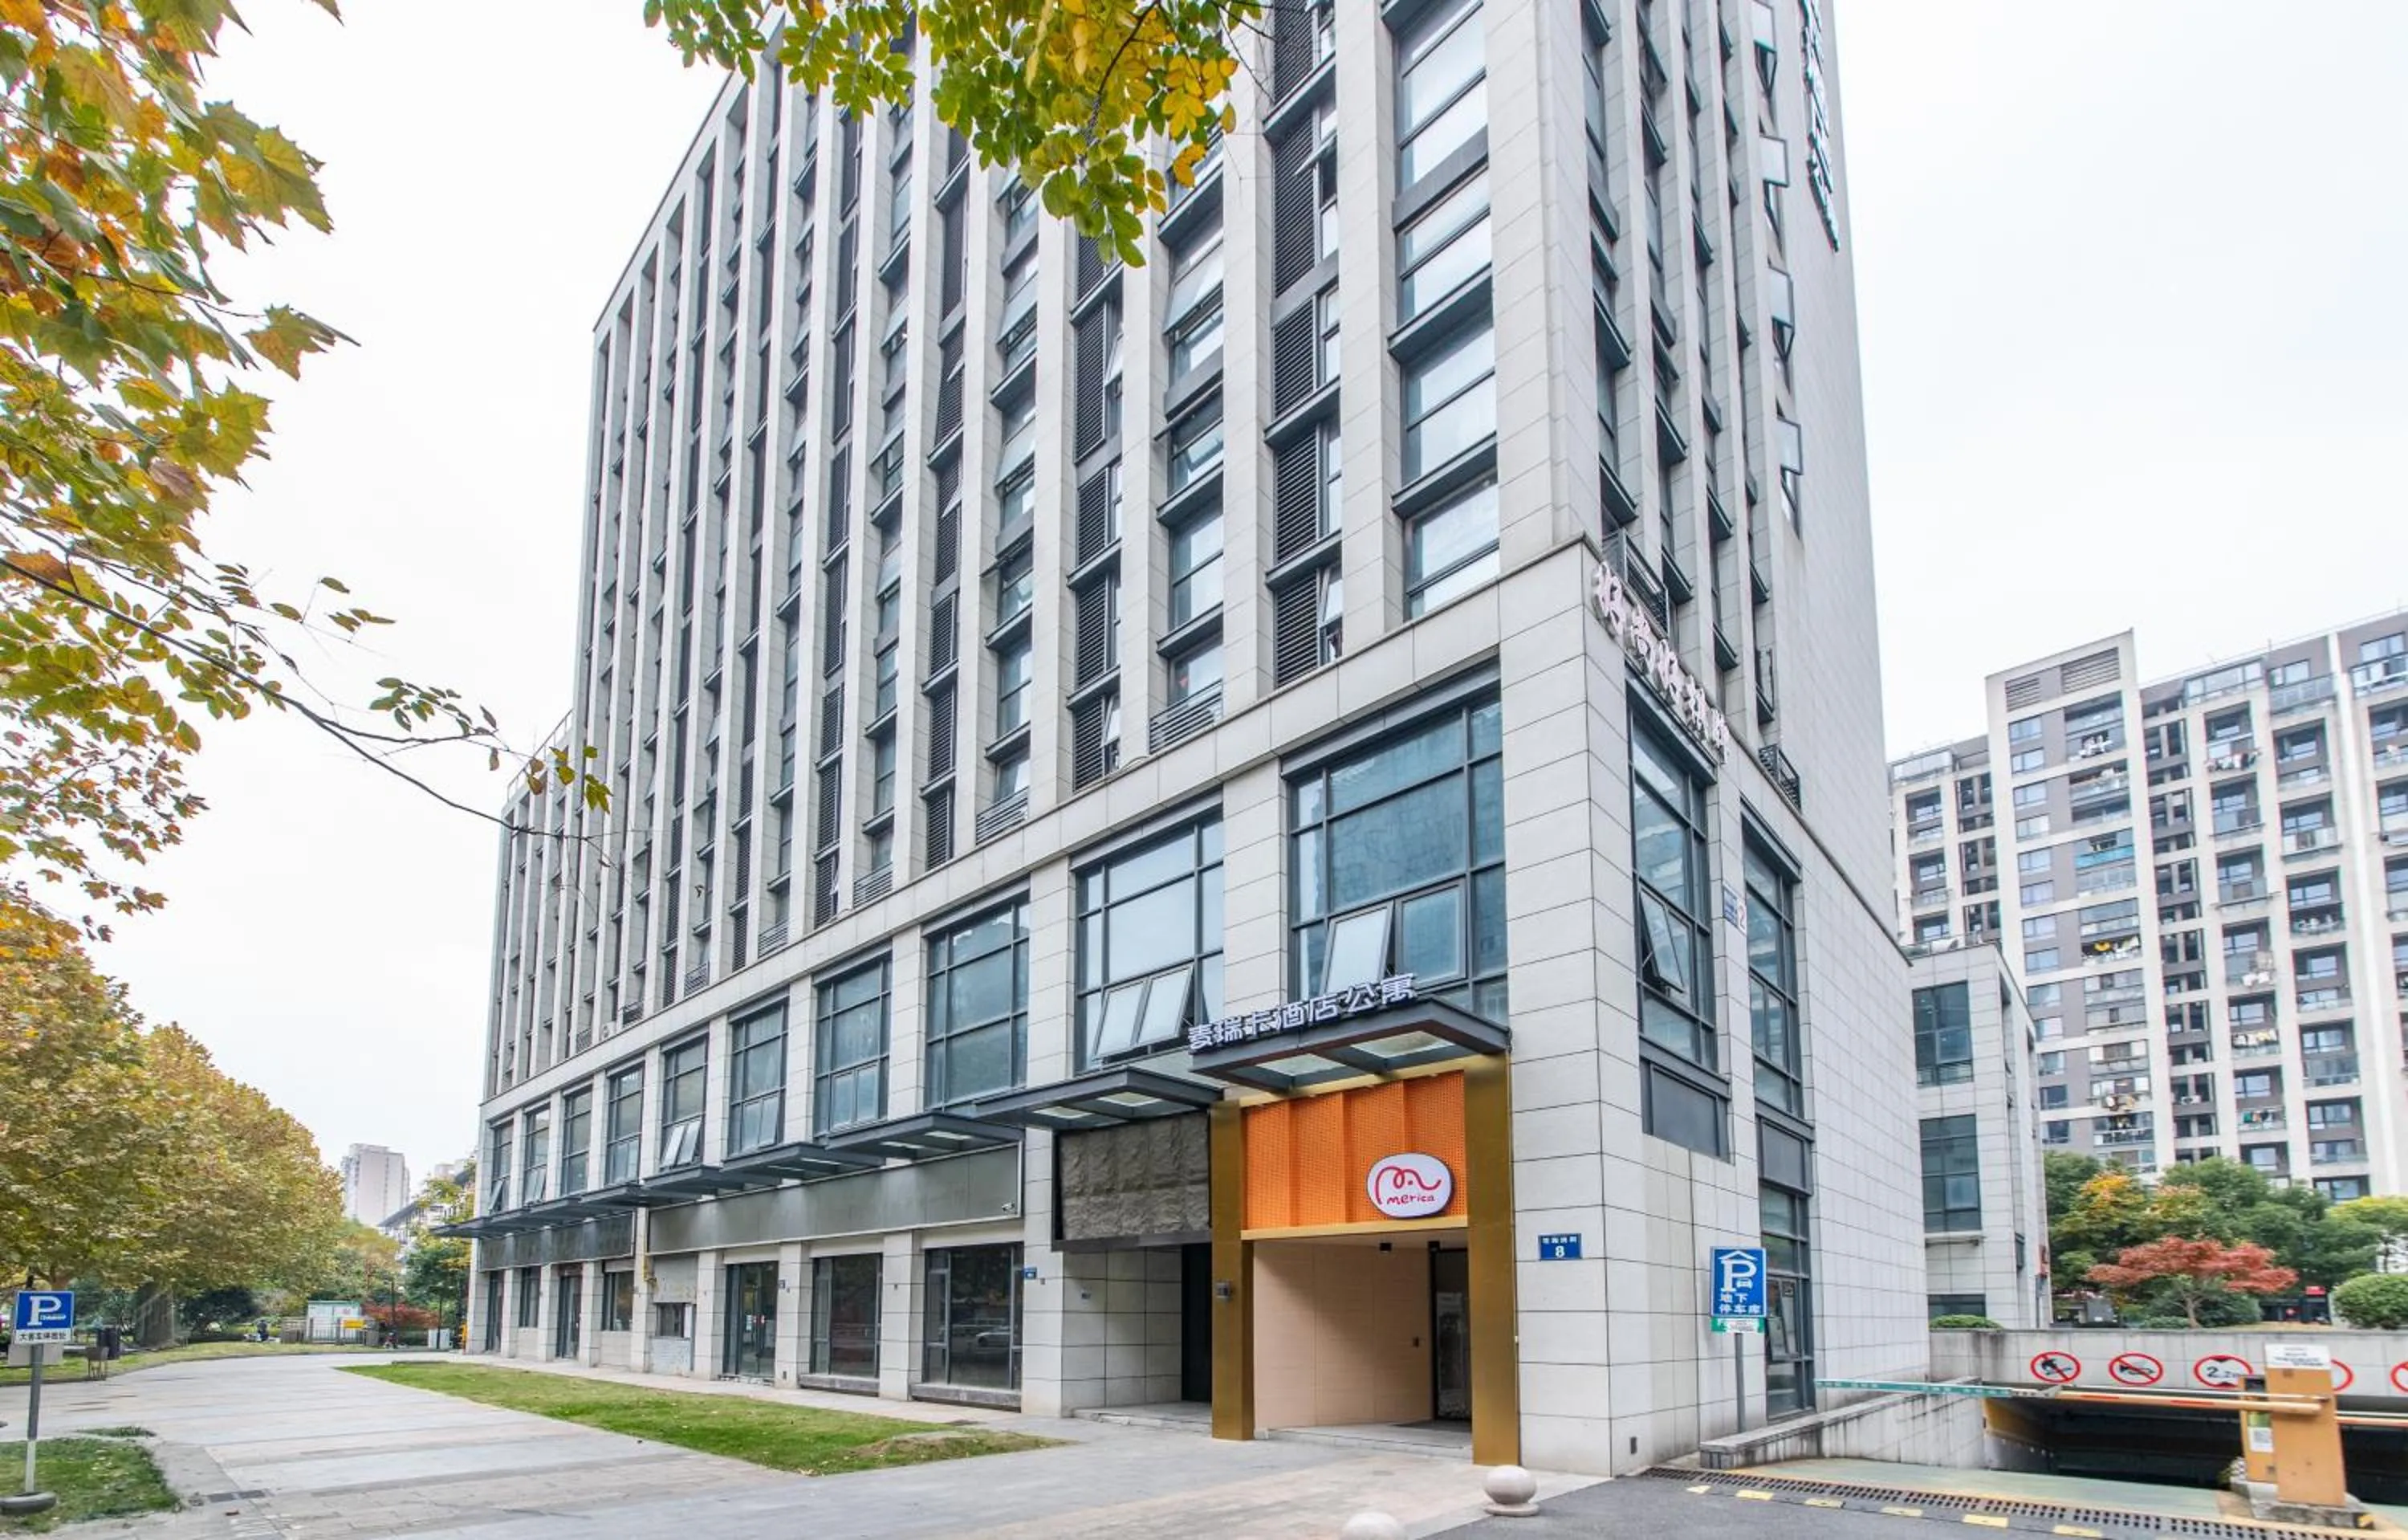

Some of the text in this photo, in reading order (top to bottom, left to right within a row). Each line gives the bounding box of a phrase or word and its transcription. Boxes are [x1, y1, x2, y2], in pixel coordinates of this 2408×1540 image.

[1188, 973, 1416, 1050] 麦瑞卡酒店公寓
[1387, 1194, 1435, 1205] merica
[1555, 1245, 1565, 1258] 8
[1720, 1260, 1757, 1292] P
[1719, 1292, 1748, 1303] 地下
[26, 1295, 62, 1326] P
[1719, 1304, 1761, 1314] 停车库
